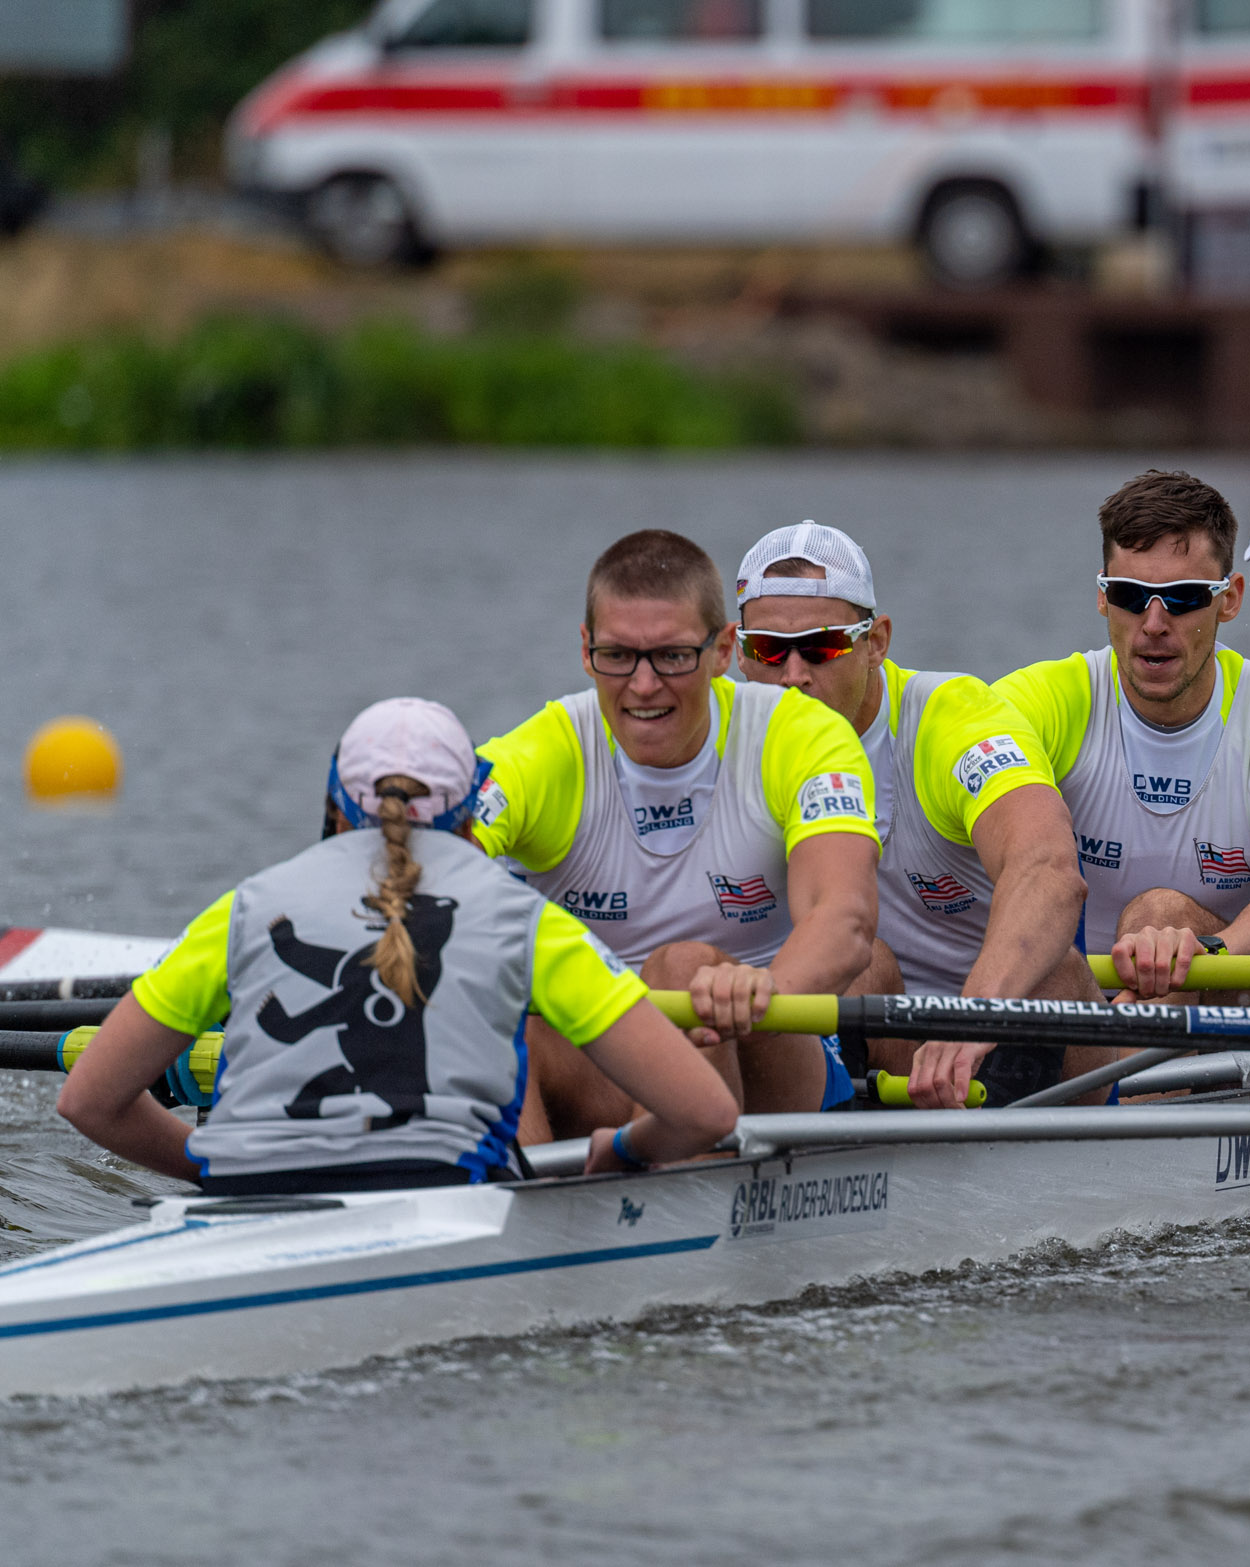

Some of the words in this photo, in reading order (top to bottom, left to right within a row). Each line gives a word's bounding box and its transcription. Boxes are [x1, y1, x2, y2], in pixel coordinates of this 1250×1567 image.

[979, 751, 1026, 775] RBL
[1133, 774, 1191, 795] DWB
[634, 798, 693, 825] DWB
[824, 796, 866, 815] RBL
[1073, 831, 1122, 858] WB
[1219, 876, 1250, 884] ARKONA
[565, 890, 628, 909] DWB
[943, 896, 978, 910] ARKONA
[740, 913, 768, 924] BERLIN
[742, 903, 777, 917] ARKONA
[896, 994, 986, 1011] STARK.
[990, 997, 1114, 1016] SCHNELL.
[1117, 1003, 1178, 1018] GUT.
[746, 1179, 777, 1223] RBL
[779, 1172, 888, 1223] RUDER-BUNDESLIGA
